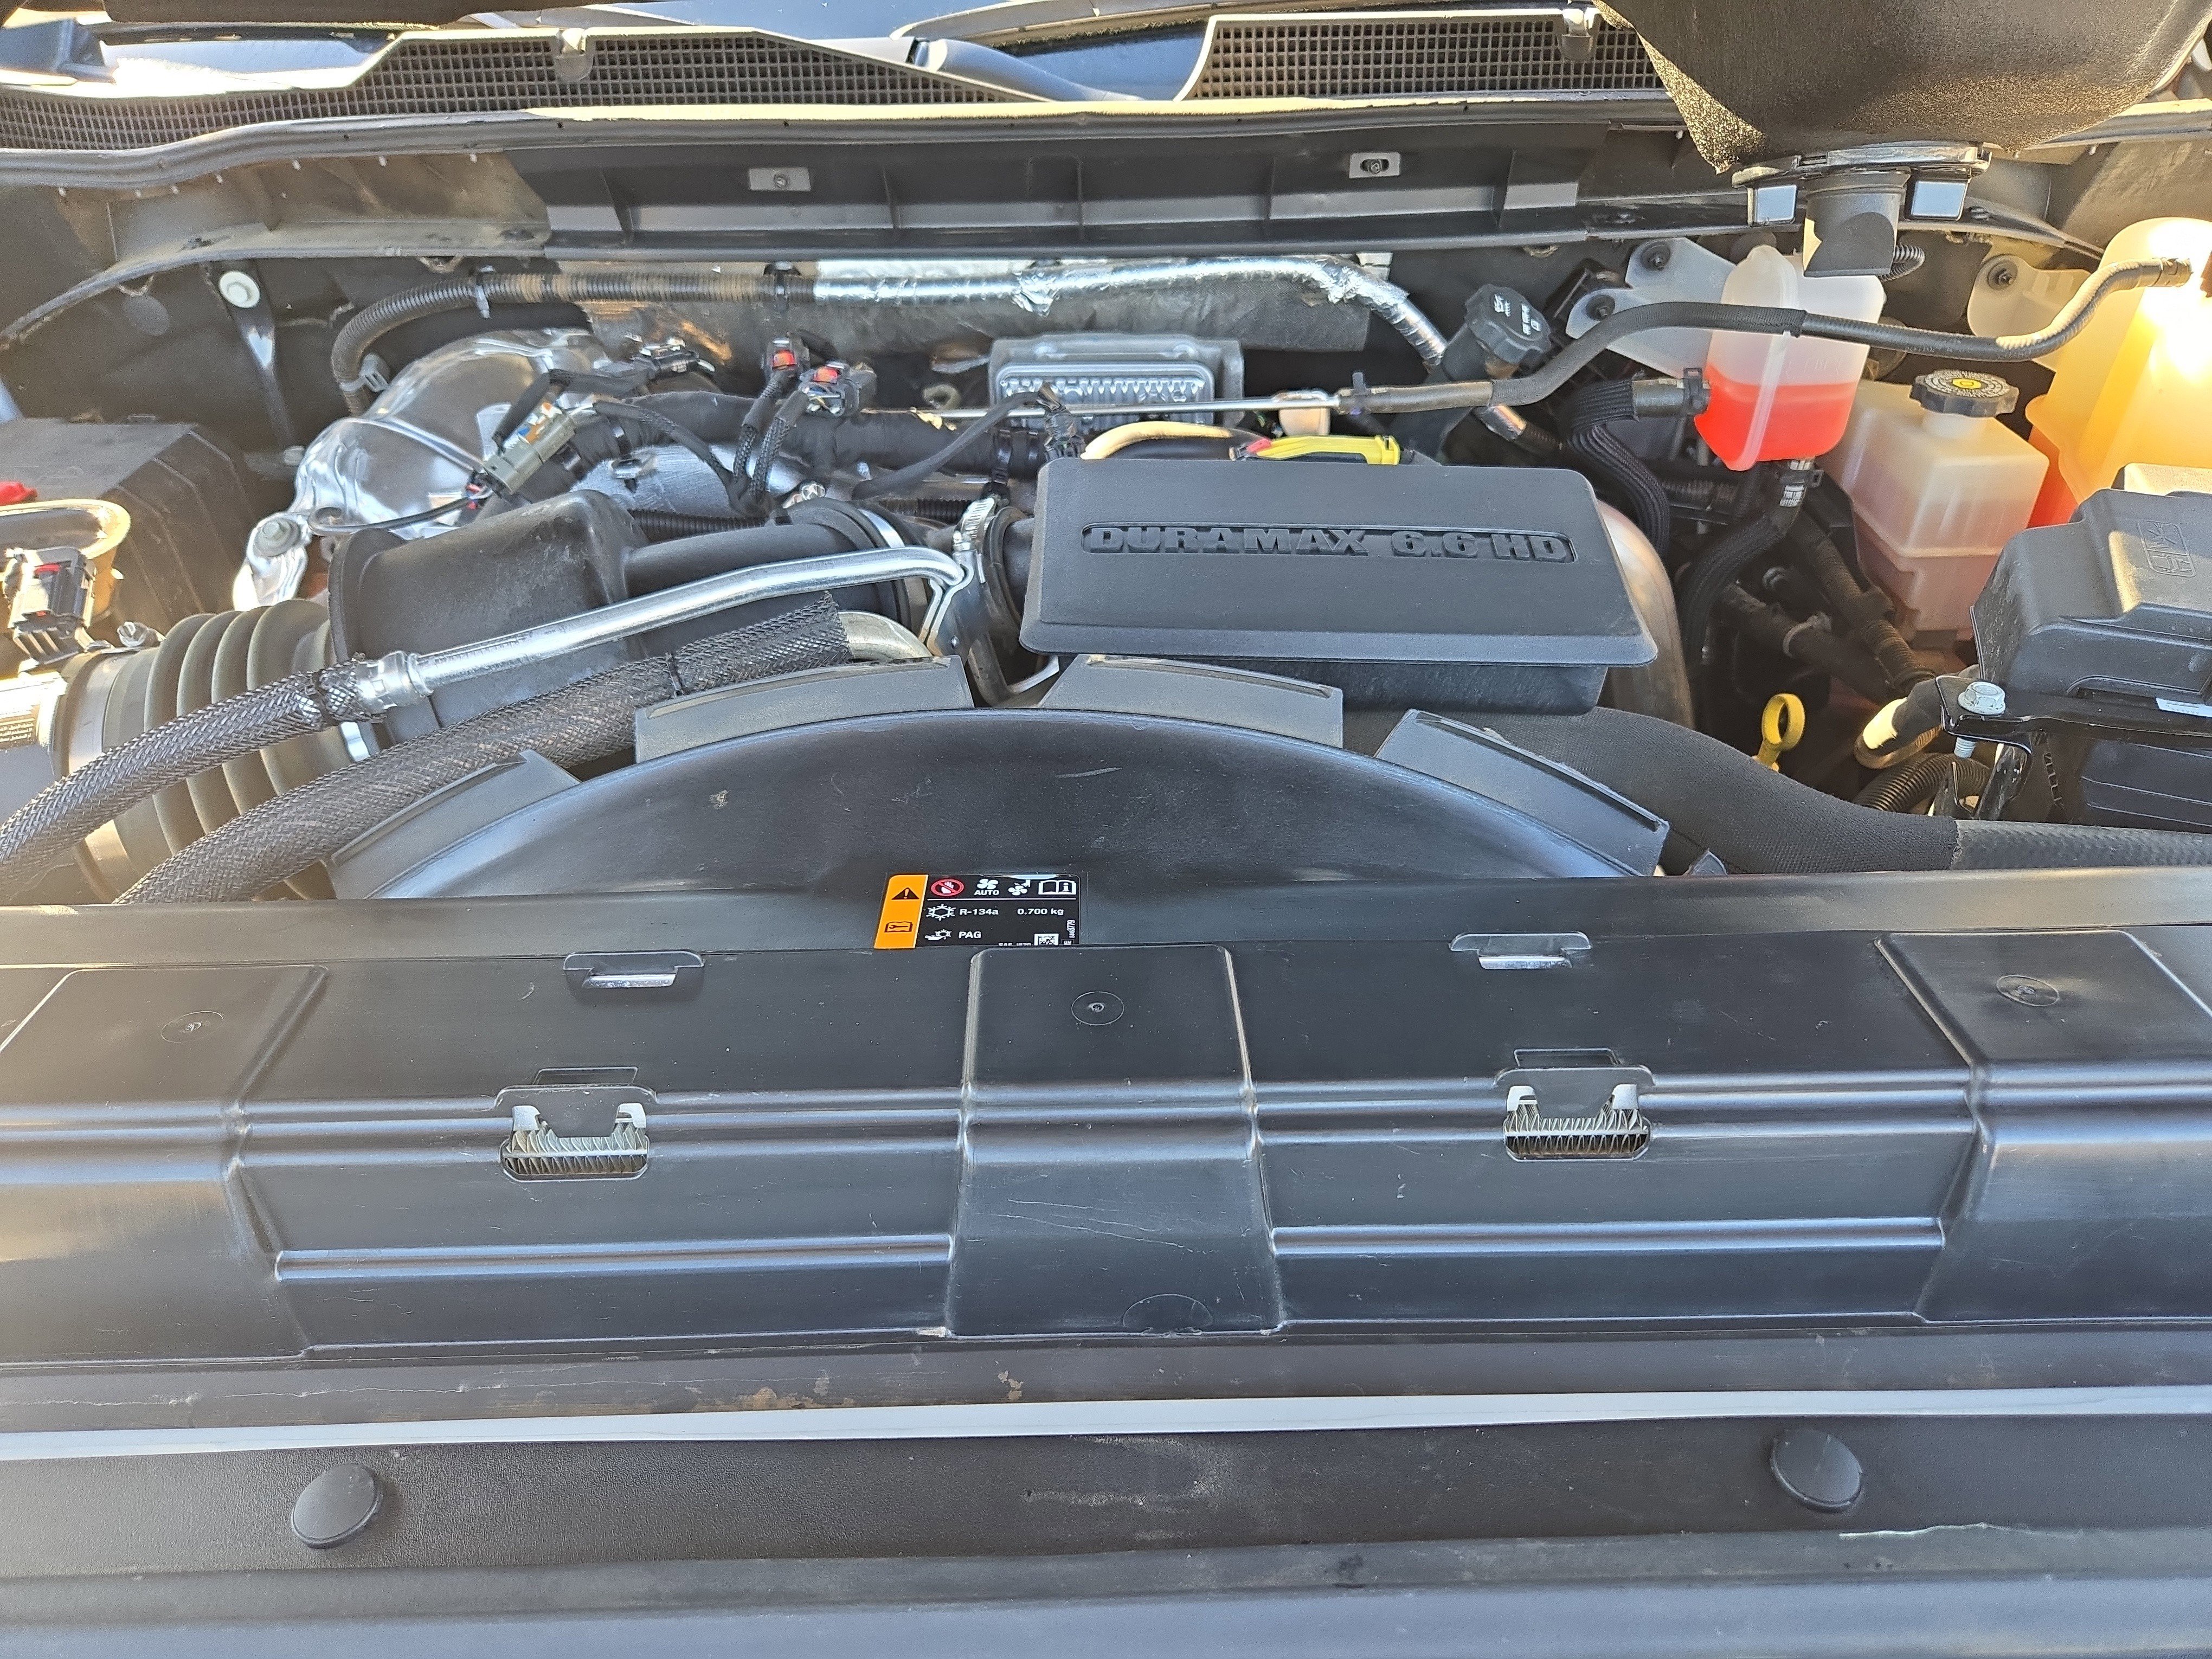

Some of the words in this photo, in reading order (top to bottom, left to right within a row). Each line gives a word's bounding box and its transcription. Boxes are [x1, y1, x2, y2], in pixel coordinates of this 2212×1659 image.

[1090, 528, 1369, 556] DURAMAX
[1391, 531, 1478, 558] 6.6
[1491, 533, 1566, 562] HD
[1050, 908, 1064, 916] kg
[958, 931, 982, 939] PAG
